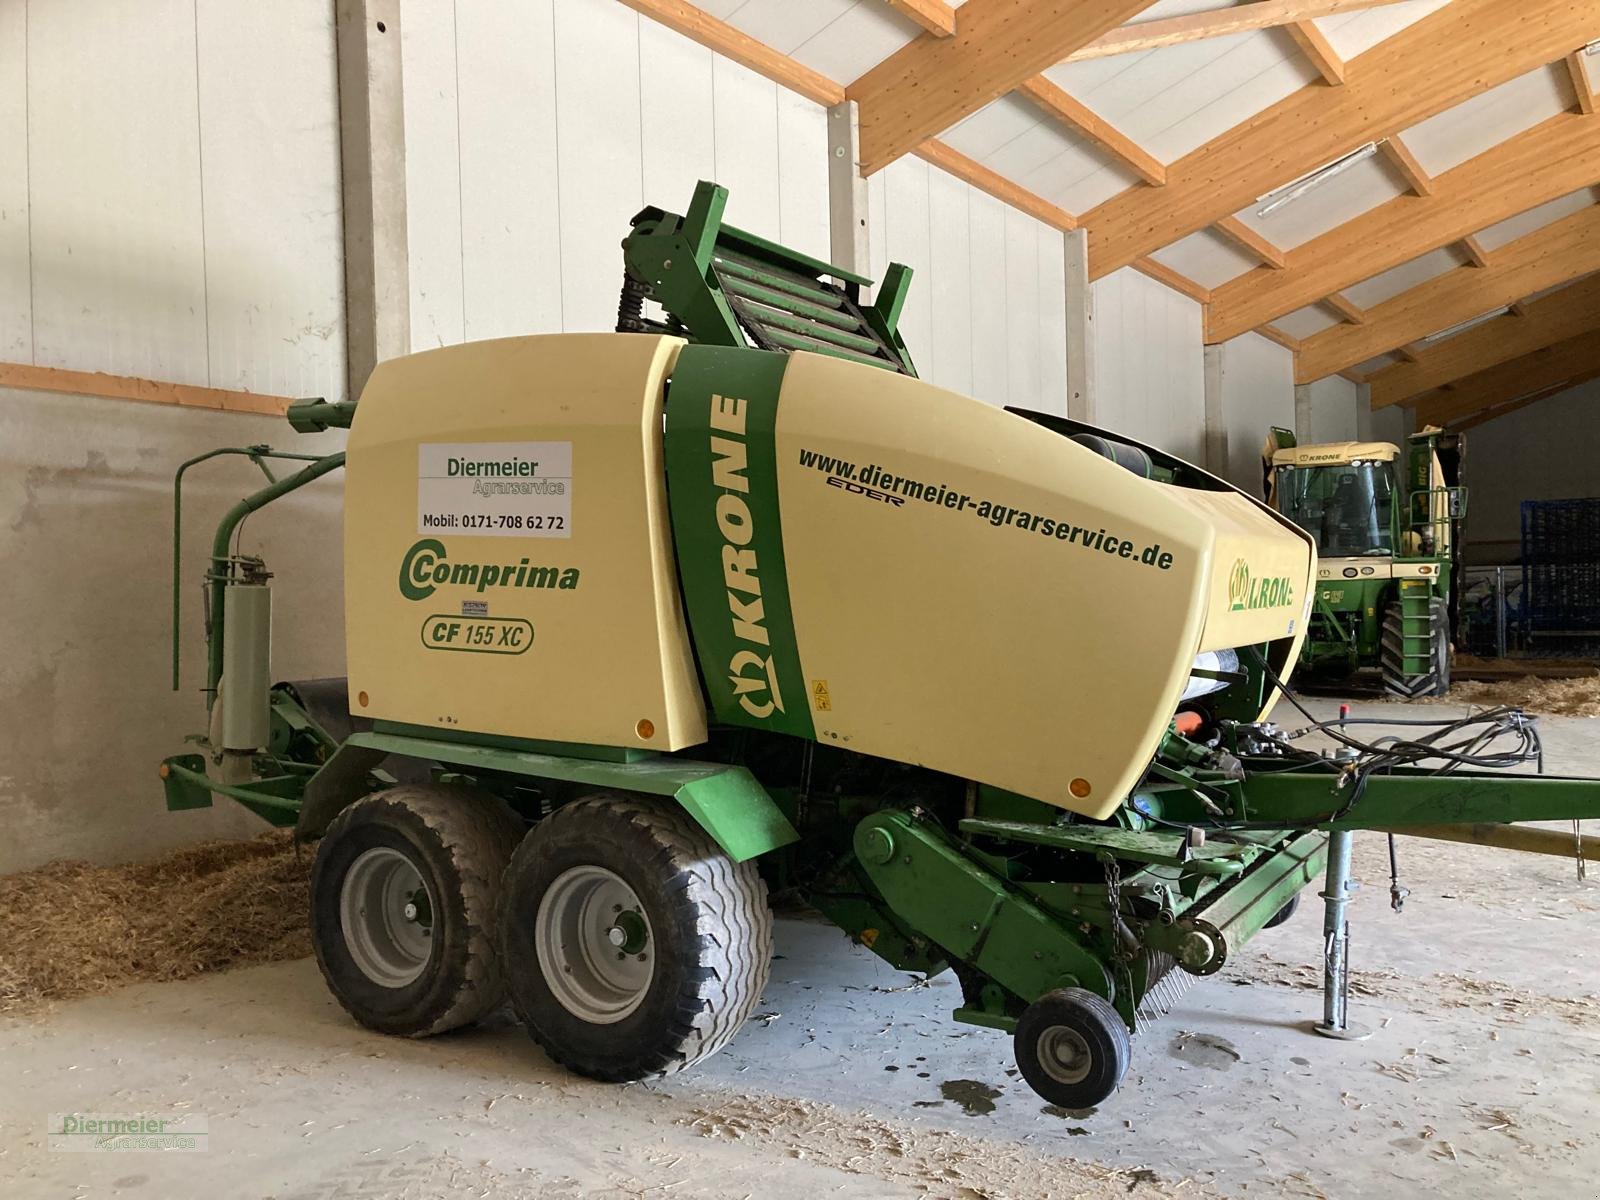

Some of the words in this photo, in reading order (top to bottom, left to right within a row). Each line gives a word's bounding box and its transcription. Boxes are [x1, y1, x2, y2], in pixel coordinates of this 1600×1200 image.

[447, 457, 539, 477] Diermeier
[1309, 453, 1341, 461] KRONE
[472, 479, 565, 497] Agrarservice
[826, 476, 905, 507] EDER
[710, 394, 770, 646] KRONE
[799, 449, 1174, 570] www.diermeier-agrarservice.de
[423, 514, 459, 528] Mobil:
[462, 515, 523, 529] 0171-708
[526, 516, 543, 529] 62
[547, 516, 564, 530] 72
[432, 622, 461, 643] CF
[466, 624, 495, 645] 155
[498, 625, 524, 647] XC
